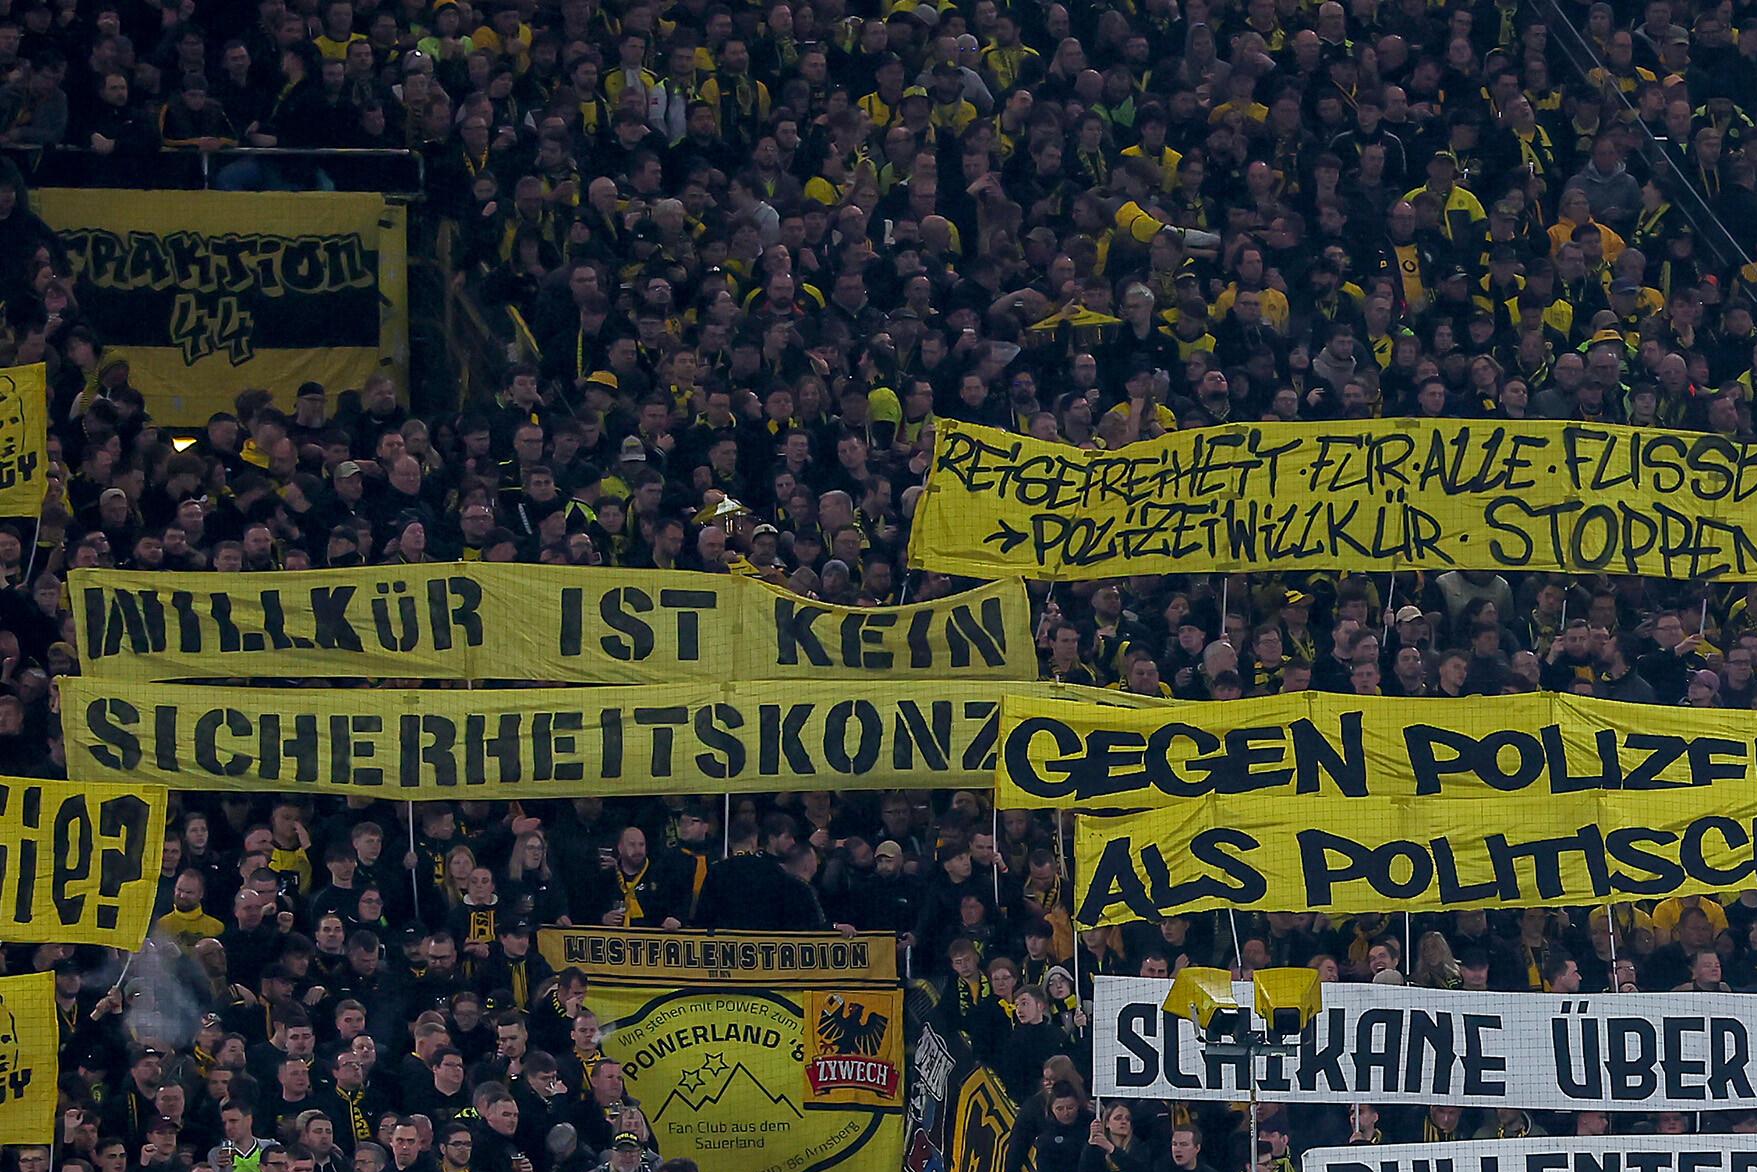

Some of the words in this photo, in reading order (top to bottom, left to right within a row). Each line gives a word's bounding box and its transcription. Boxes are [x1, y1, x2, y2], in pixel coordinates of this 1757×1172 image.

[171, 293, 256, 367] 44
[1420, 428, 1548, 495] ALLE
[83, 576, 484, 660] WILLKÜR
[560, 587, 717, 661] IST
[775, 597, 1006, 669] KEIN
[1005, 711, 1369, 800] GEGEN
[0, 784, 151, 930] ie?
[1076, 827, 1267, 927] ALS
[563, 935, 870, 969] WESTFALENSTADION
[618, 1026, 646, 1048] WIR
[645, 1005, 688, 1033] stehen
[689, 1000, 713, 1014] mit
[716, 1000, 769, 1016] POWER
[771, 1011, 799, 1031] zum
[622, 1023, 781, 1081] POWERLAND
[1551, 1000, 1756, 1101] ÜBER
[668, 1122, 693, 1134] Fan
[696, 1121, 727, 1134] Club
[730, 1123, 754, 1133] aus
[758, 1120, 791, 1133] dem
[695, 1137, 765, 1150] Sauerland
[805, 1120, 860, 1158] Arnsberg
